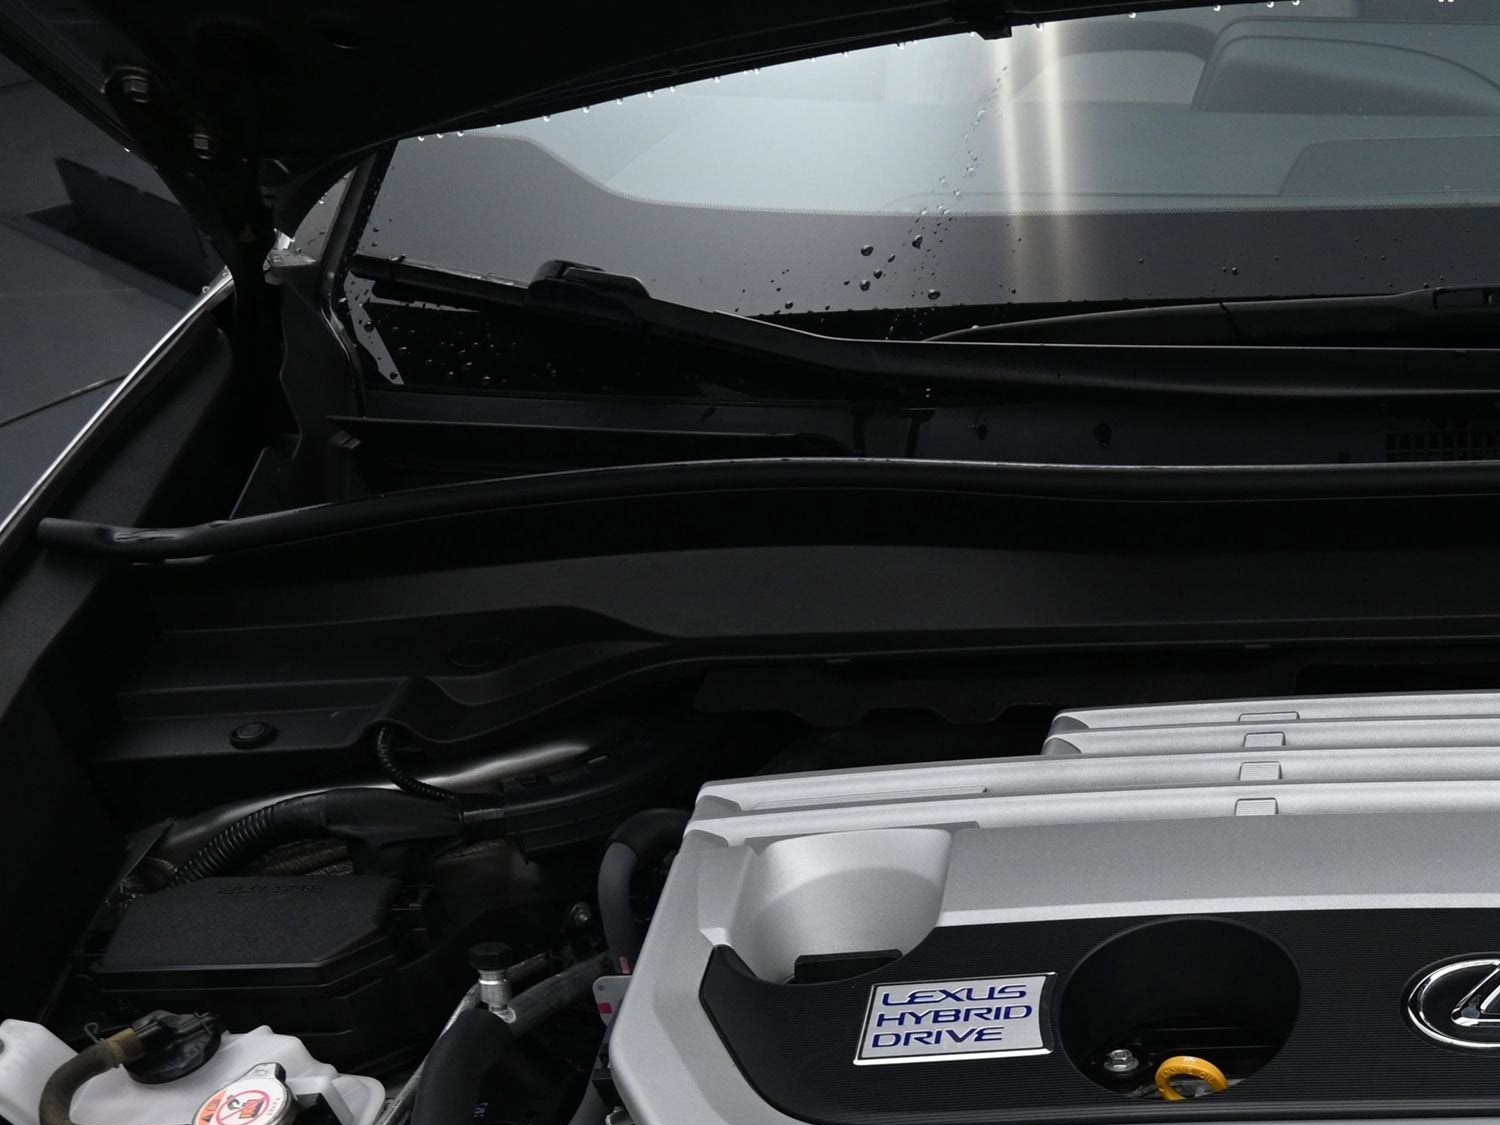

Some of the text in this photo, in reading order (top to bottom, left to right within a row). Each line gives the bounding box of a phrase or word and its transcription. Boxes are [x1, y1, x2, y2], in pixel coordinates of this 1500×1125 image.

[882, 985, 1027, 1006] LEXUS
[876, 1005, 1033, 1027] HYBRID
[872, 1027, 1005, 1048] DRIVE
